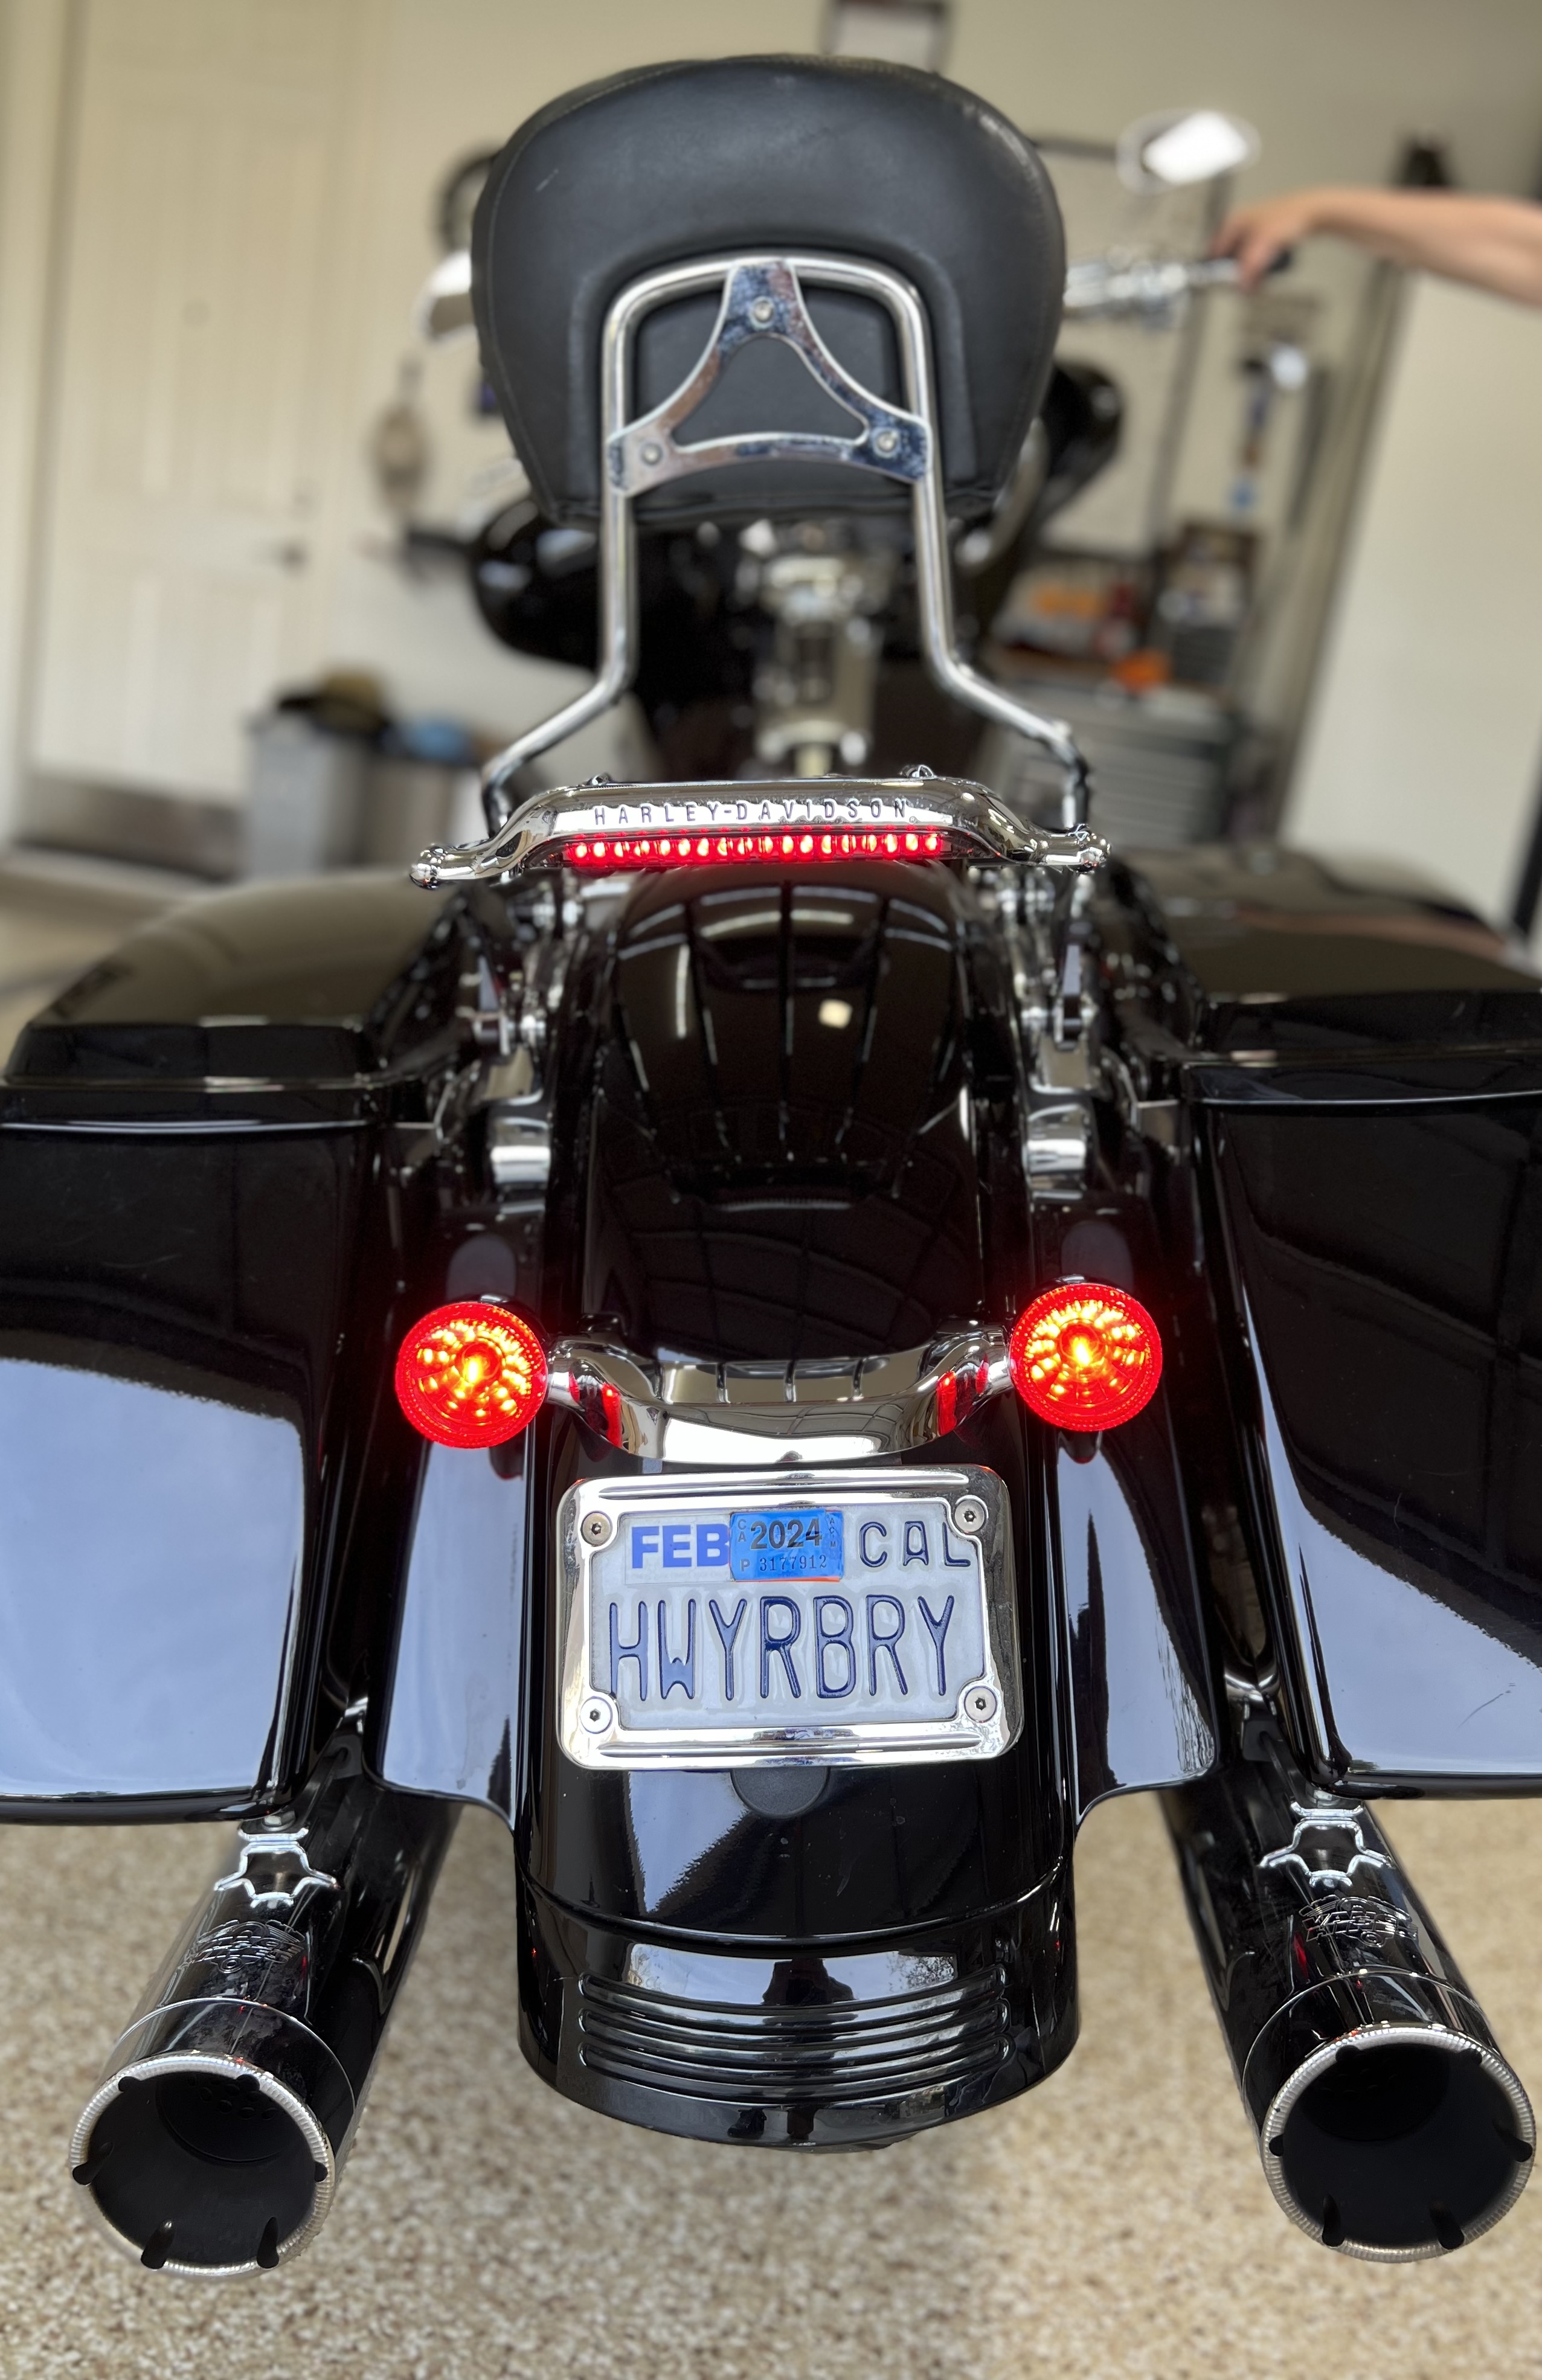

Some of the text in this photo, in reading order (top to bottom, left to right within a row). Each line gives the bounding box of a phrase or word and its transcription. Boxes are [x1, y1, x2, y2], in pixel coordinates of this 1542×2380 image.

[593, 797, 906, 825] HARLEY-DAVIDSON
[631, 1523, 730, 1569] FEB
[750, 1518, 823, 1550] 2024
[859, 1521, 971, 1568] CAL
[759, 1554, 827, 1571] 3177912
[609, 1594, 954, 1701] HWYRBRY
